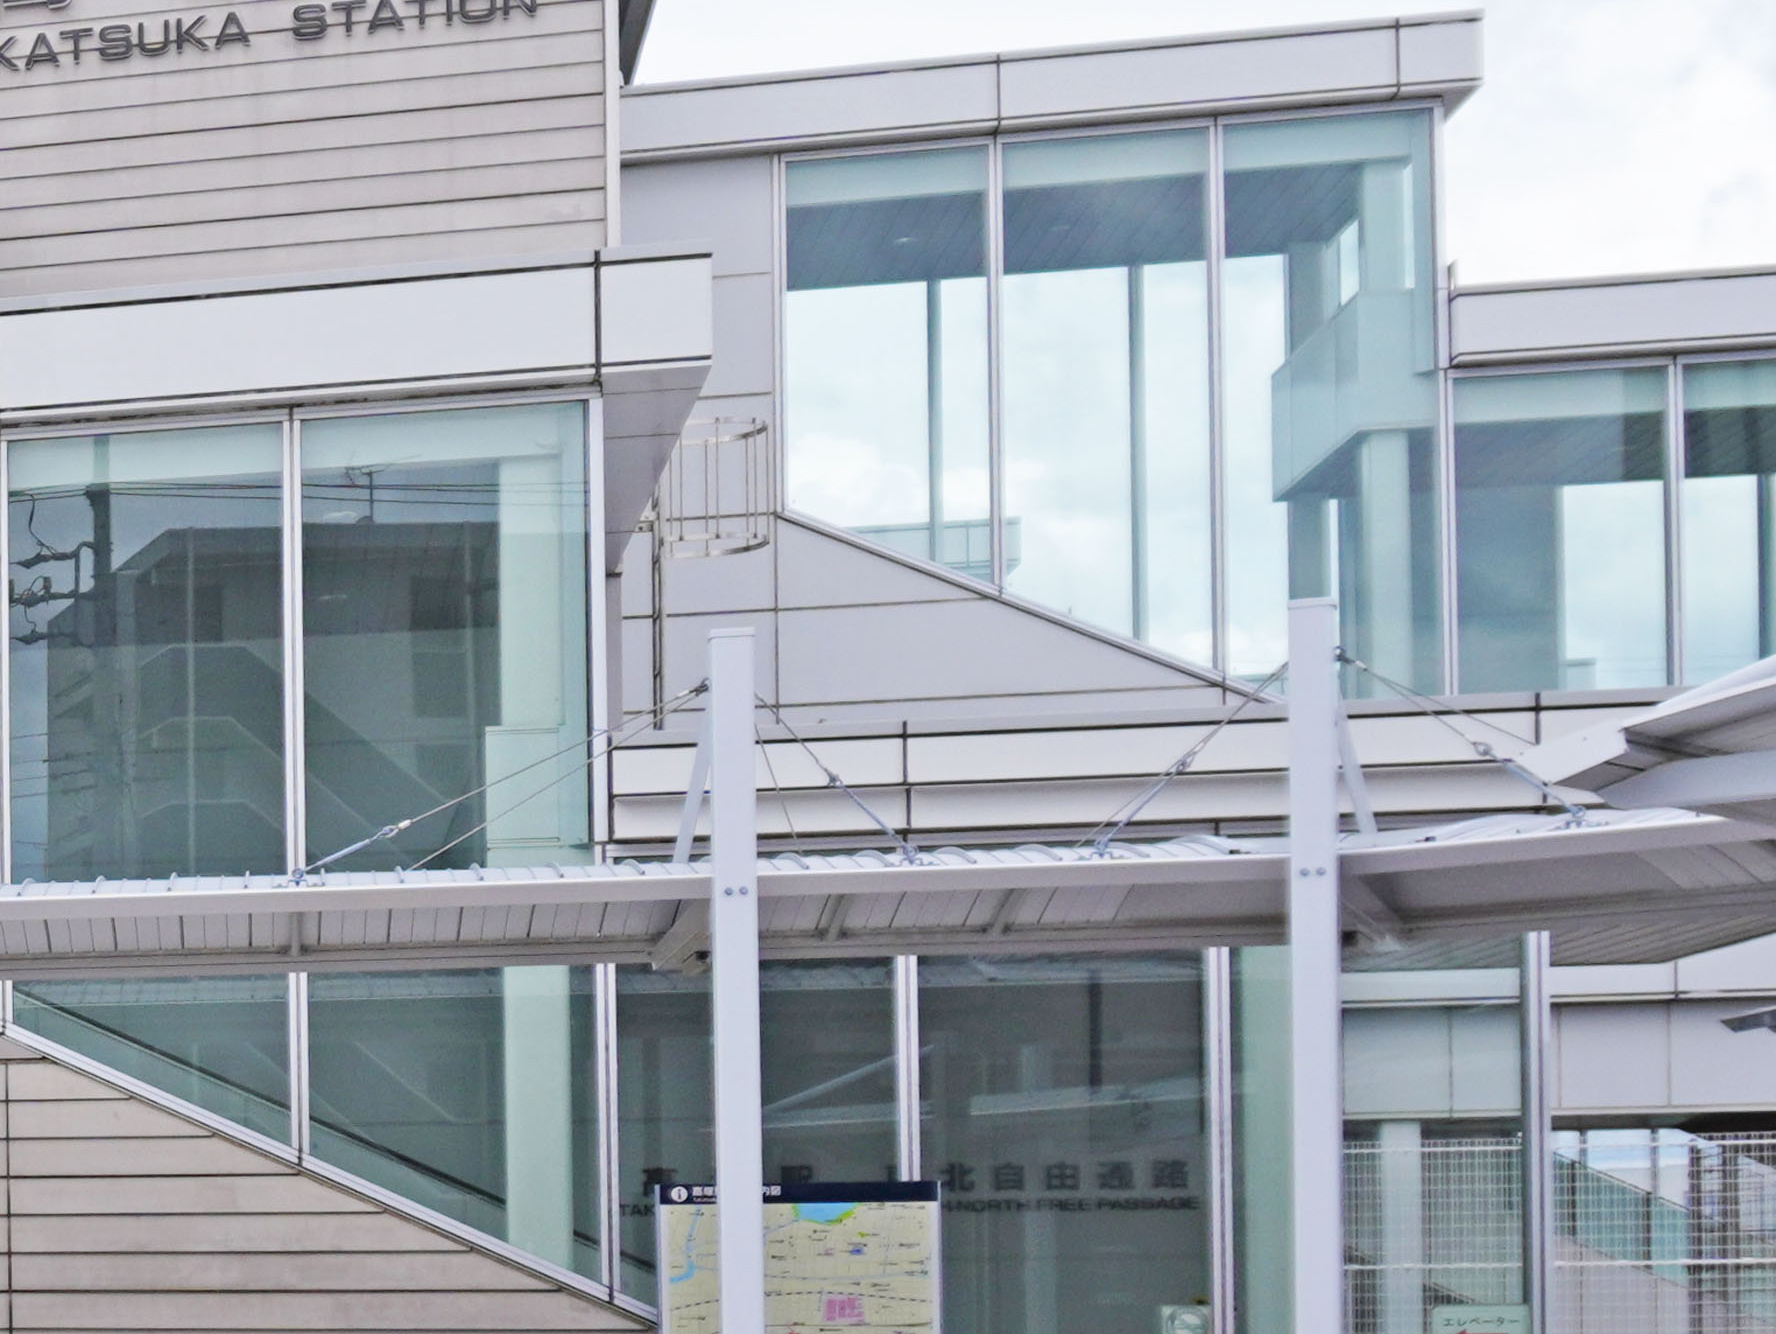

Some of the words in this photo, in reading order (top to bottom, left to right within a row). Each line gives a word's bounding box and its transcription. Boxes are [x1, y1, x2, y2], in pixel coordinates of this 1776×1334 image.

[1036, 1197, 1090, 1212] FREE
[1096, 1195, 1201, 1212] PASSAGE
[1443, 1316, 1520, 1327] エレベーター
